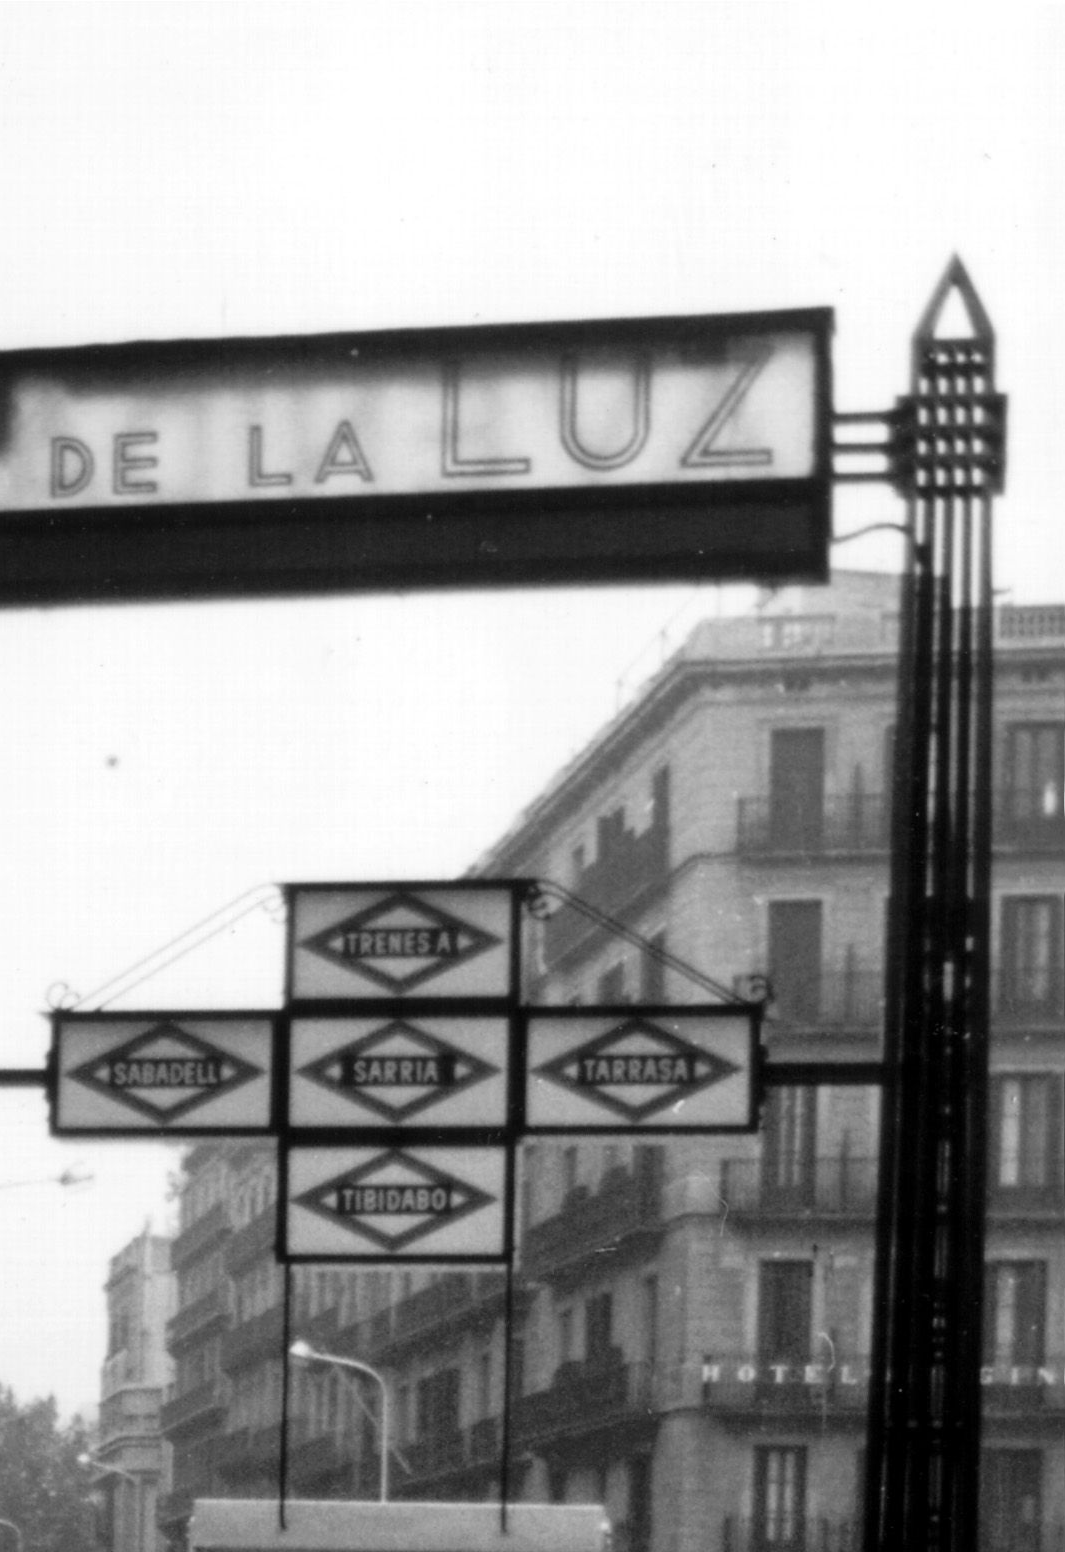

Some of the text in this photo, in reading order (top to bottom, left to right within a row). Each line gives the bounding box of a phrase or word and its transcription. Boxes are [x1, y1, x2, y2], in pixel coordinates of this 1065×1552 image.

[51, 432, 158, 499] DE
[248, 420, 374, 487] LA
[440, 342, 774, 479] LUZ
[346, 931, 452, 955] TRENES A
[113, 1061, 218, 1085] SABADELL
[353, 1059, 439, 1083] SARRIA
[583, 1057, 688, 1082] TARRASA
[341, 1187, 448, 1212] TIBIDABO
[701, 1364, 858, 1386] HOTEL
